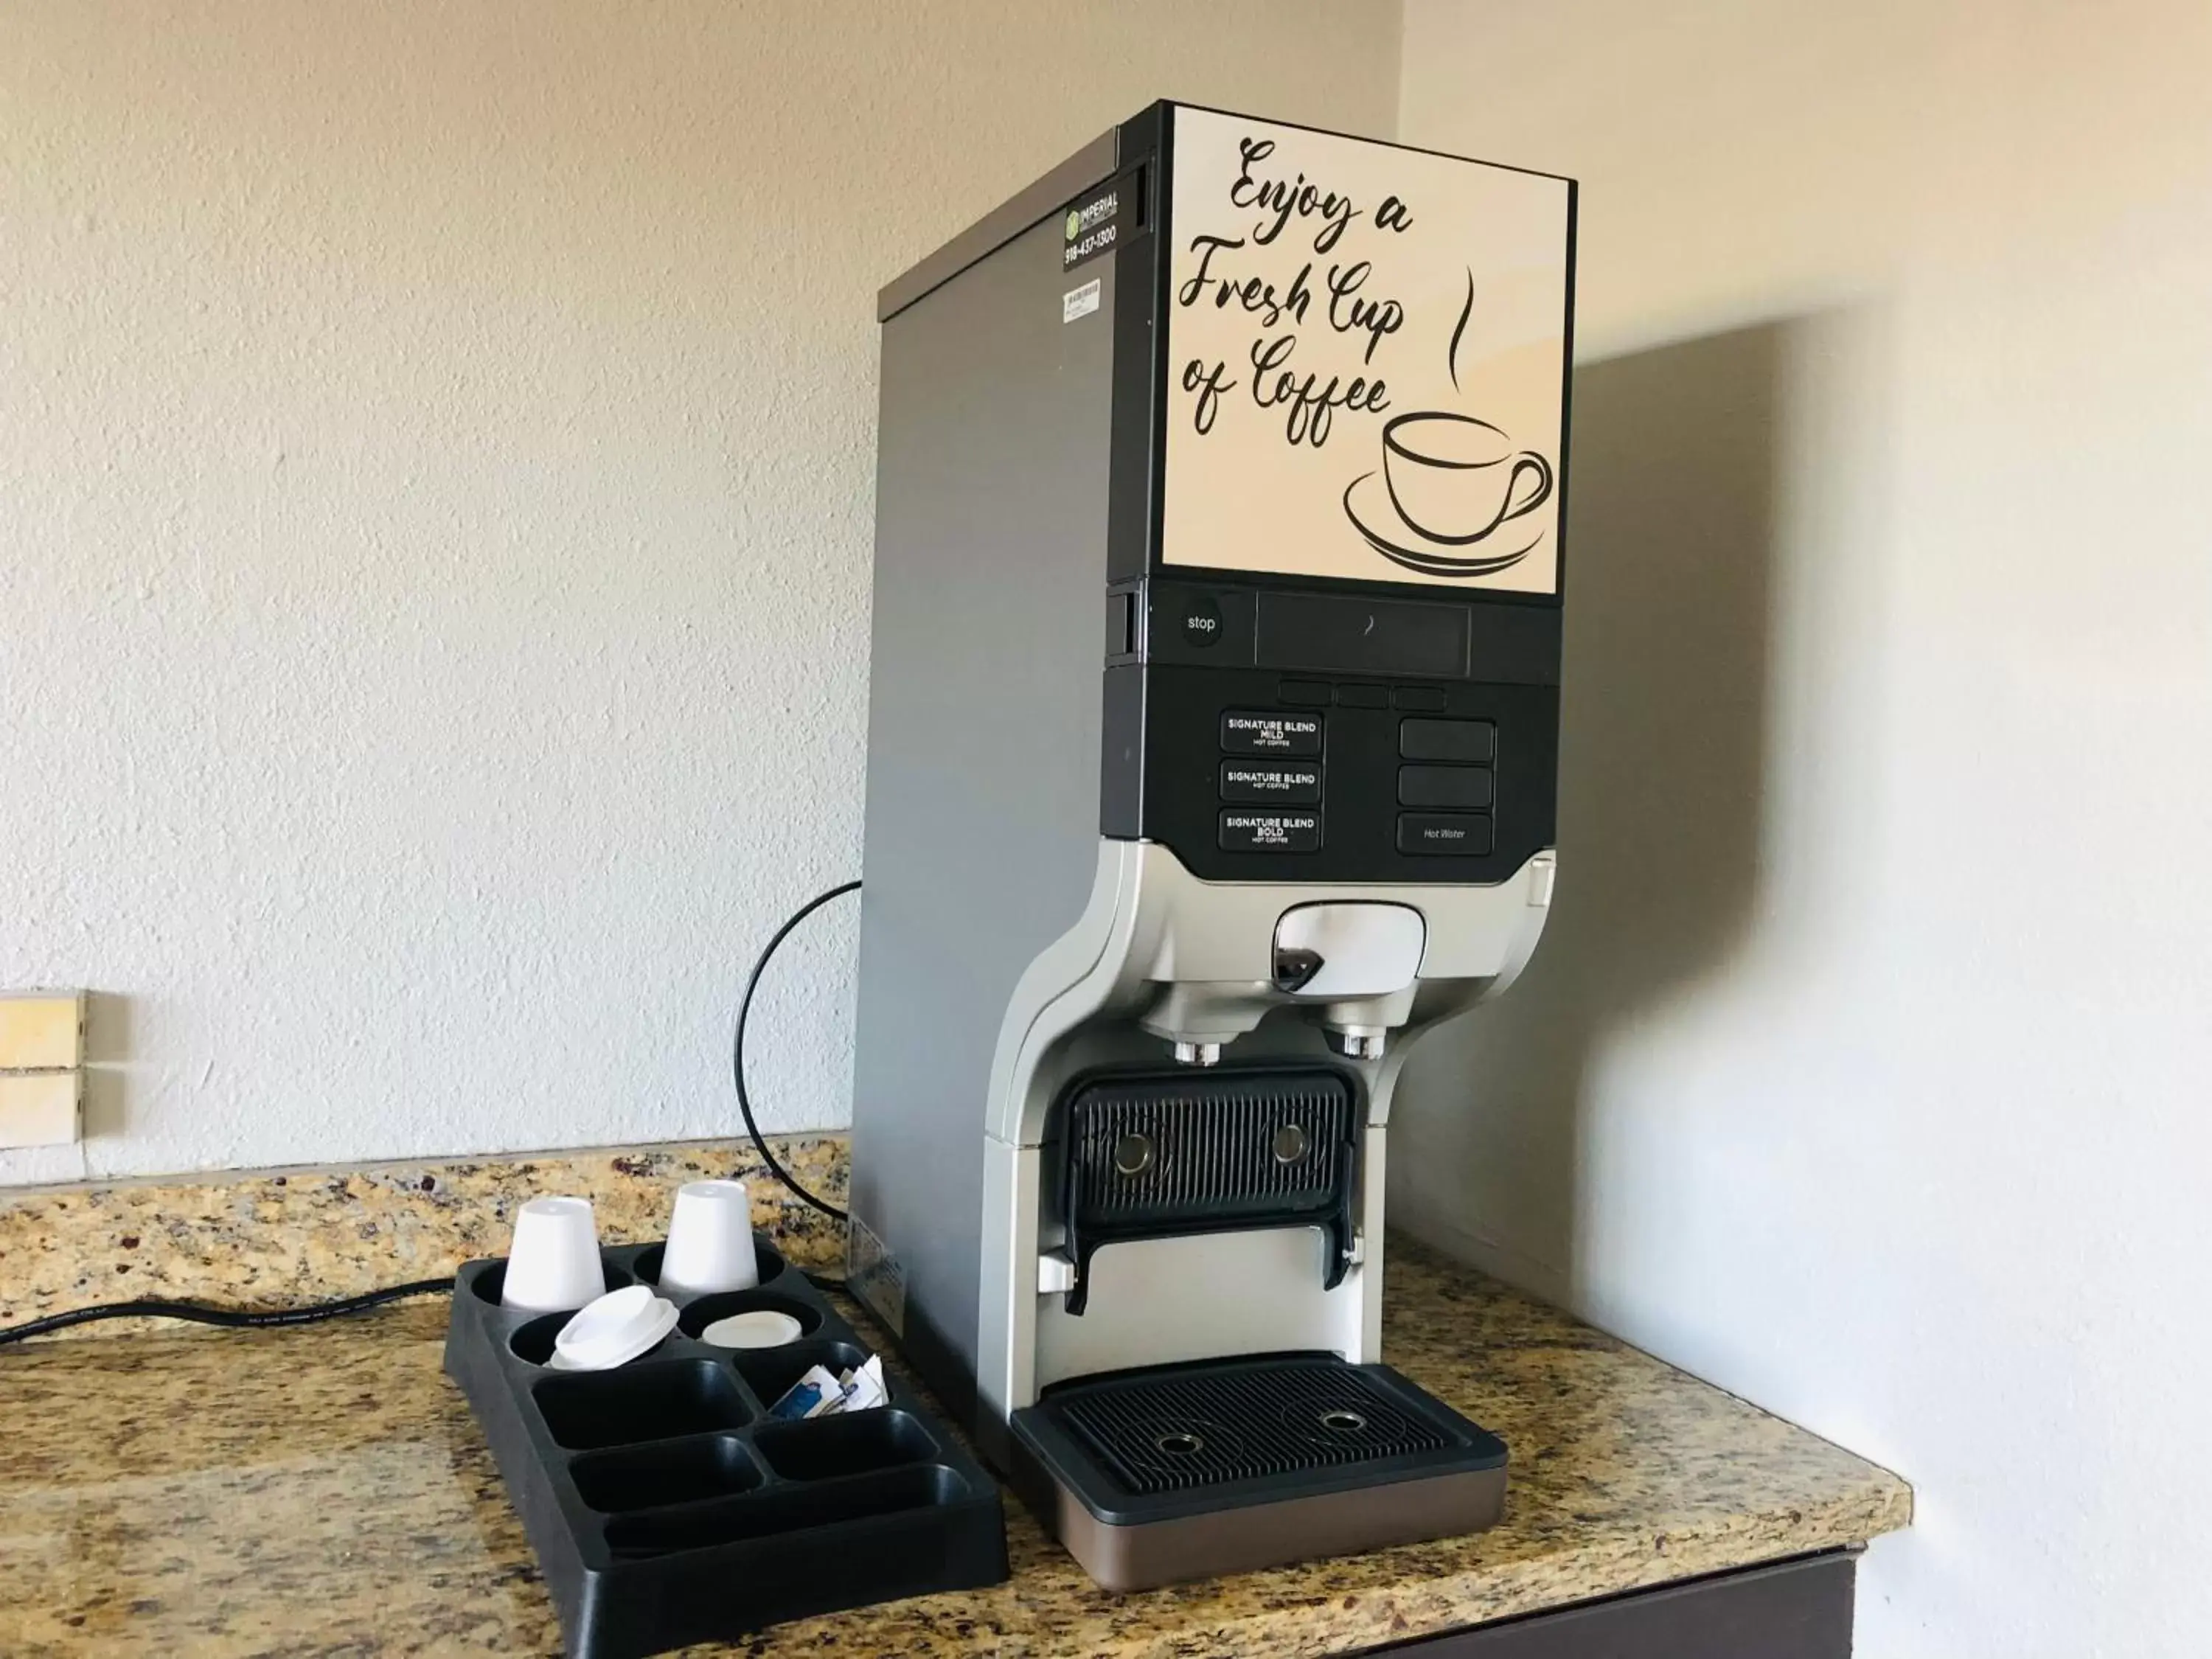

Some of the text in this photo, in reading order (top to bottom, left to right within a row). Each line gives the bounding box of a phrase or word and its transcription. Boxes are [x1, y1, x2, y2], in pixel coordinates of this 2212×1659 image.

[1231, 136, 1413, 254] Enjoy a
[1079, 191, 1119, 223] IMPERIAL
[1179, 234, 1405, 366] Fresh Cup
[1182, 334, 1391, 448] of Coffee
[1188, 615, 1216, 633] stop
[1228, 719, 1316, 732] SIGNATURE BLEND
[1260, 730, 1284, 740] MILD
[1228, 771, 1315, 784] SIGNATURE BLEND
[1226, 817, 1314, 827] SIGNATURE BLEND
[1257, 827, 1284, 837] BOLD
[1424, 828, 1466, 838] Hot Water
